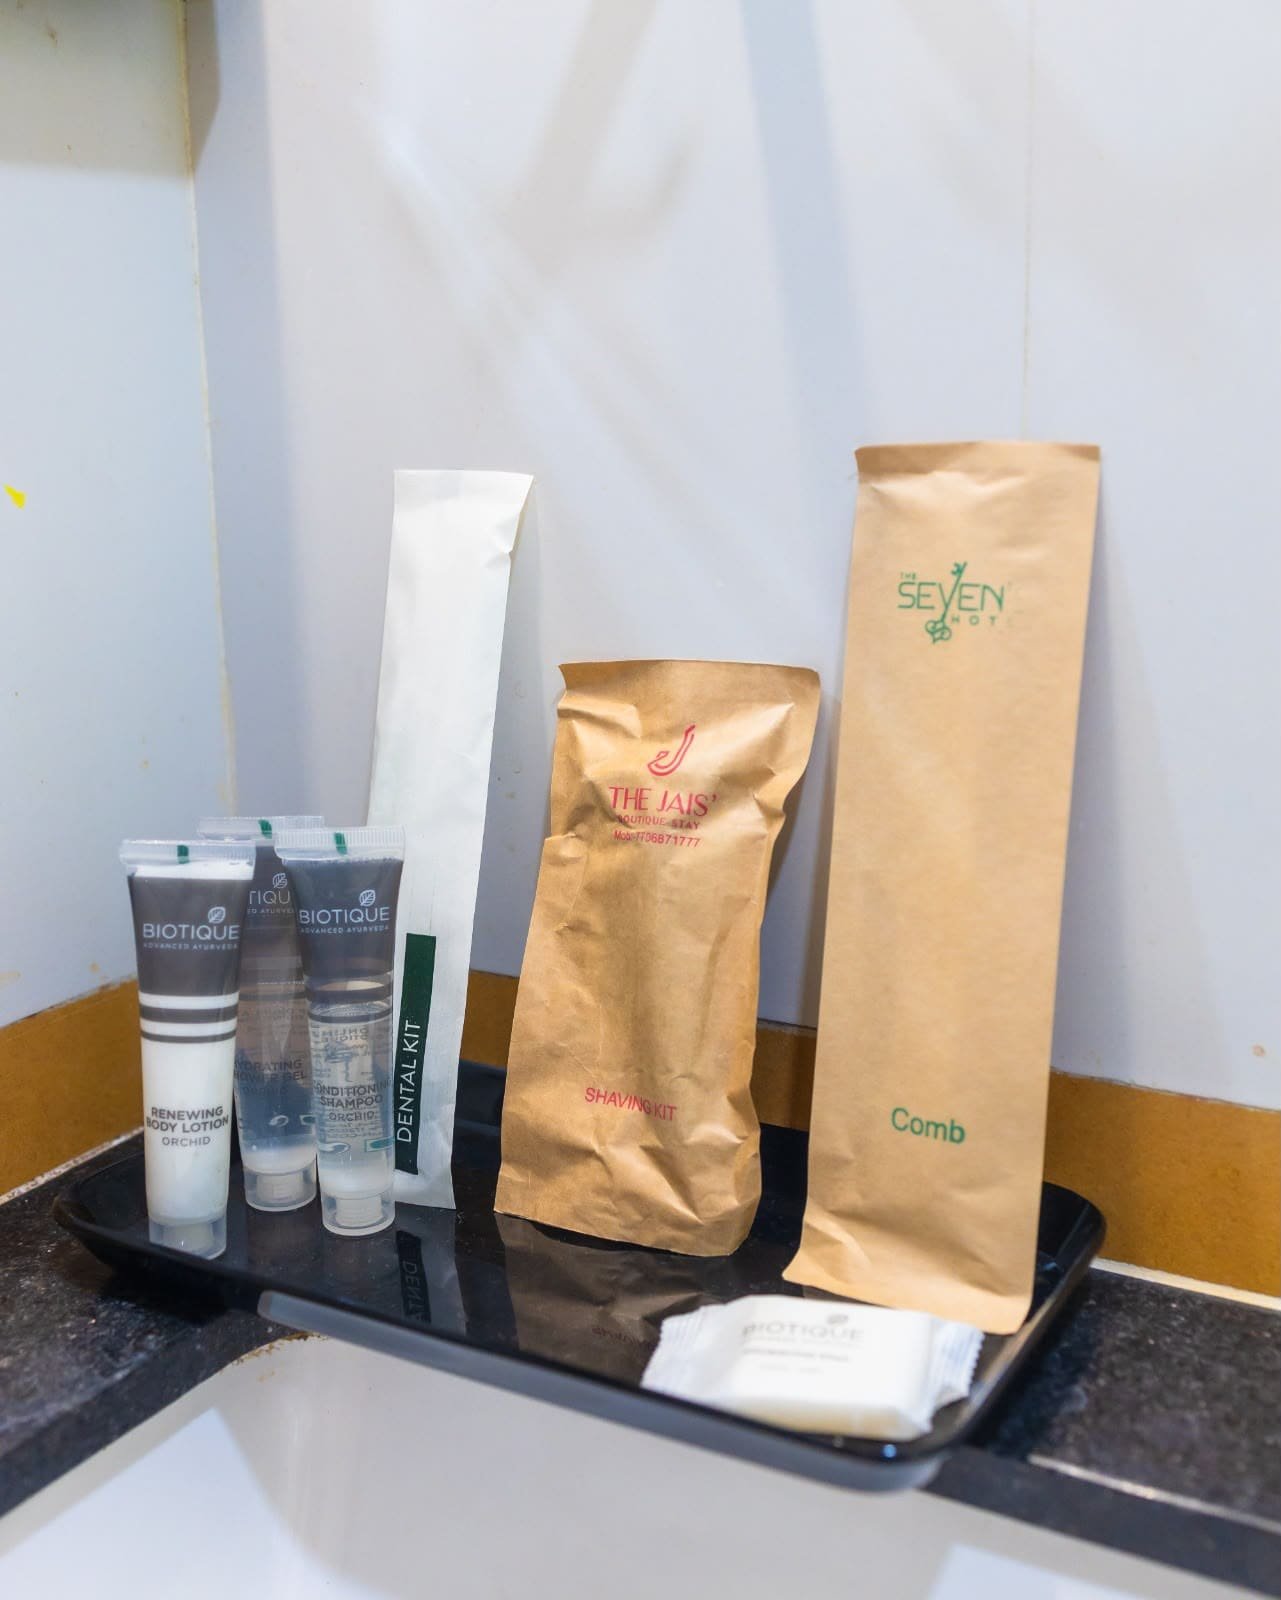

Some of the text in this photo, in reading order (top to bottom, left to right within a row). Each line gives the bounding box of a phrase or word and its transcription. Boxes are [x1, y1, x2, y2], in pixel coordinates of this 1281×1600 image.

[897, 562, 1005, 613] SEVEN
[608, 786, 718, 817] THE JAIS'
[671, 818, 700, 830] STAY
[299, 907, 390, 924] BIOTIQUE
[143, 923, 241, 940] BIOTIQUE
[396, 1019, 421, 1143] DENTAL KIT
[320, 1094, 383, 1110] SHAMPOO
[584, 1087, 678, 1121] SHAVING KIT
[151, 1106, 224, 1121] RENEWING
[146, 1114, 229, 1133] BODY LOTION
[891, 1107, 966, 1145] Comb
[162, 1136, 212, 1147] ORCHID
